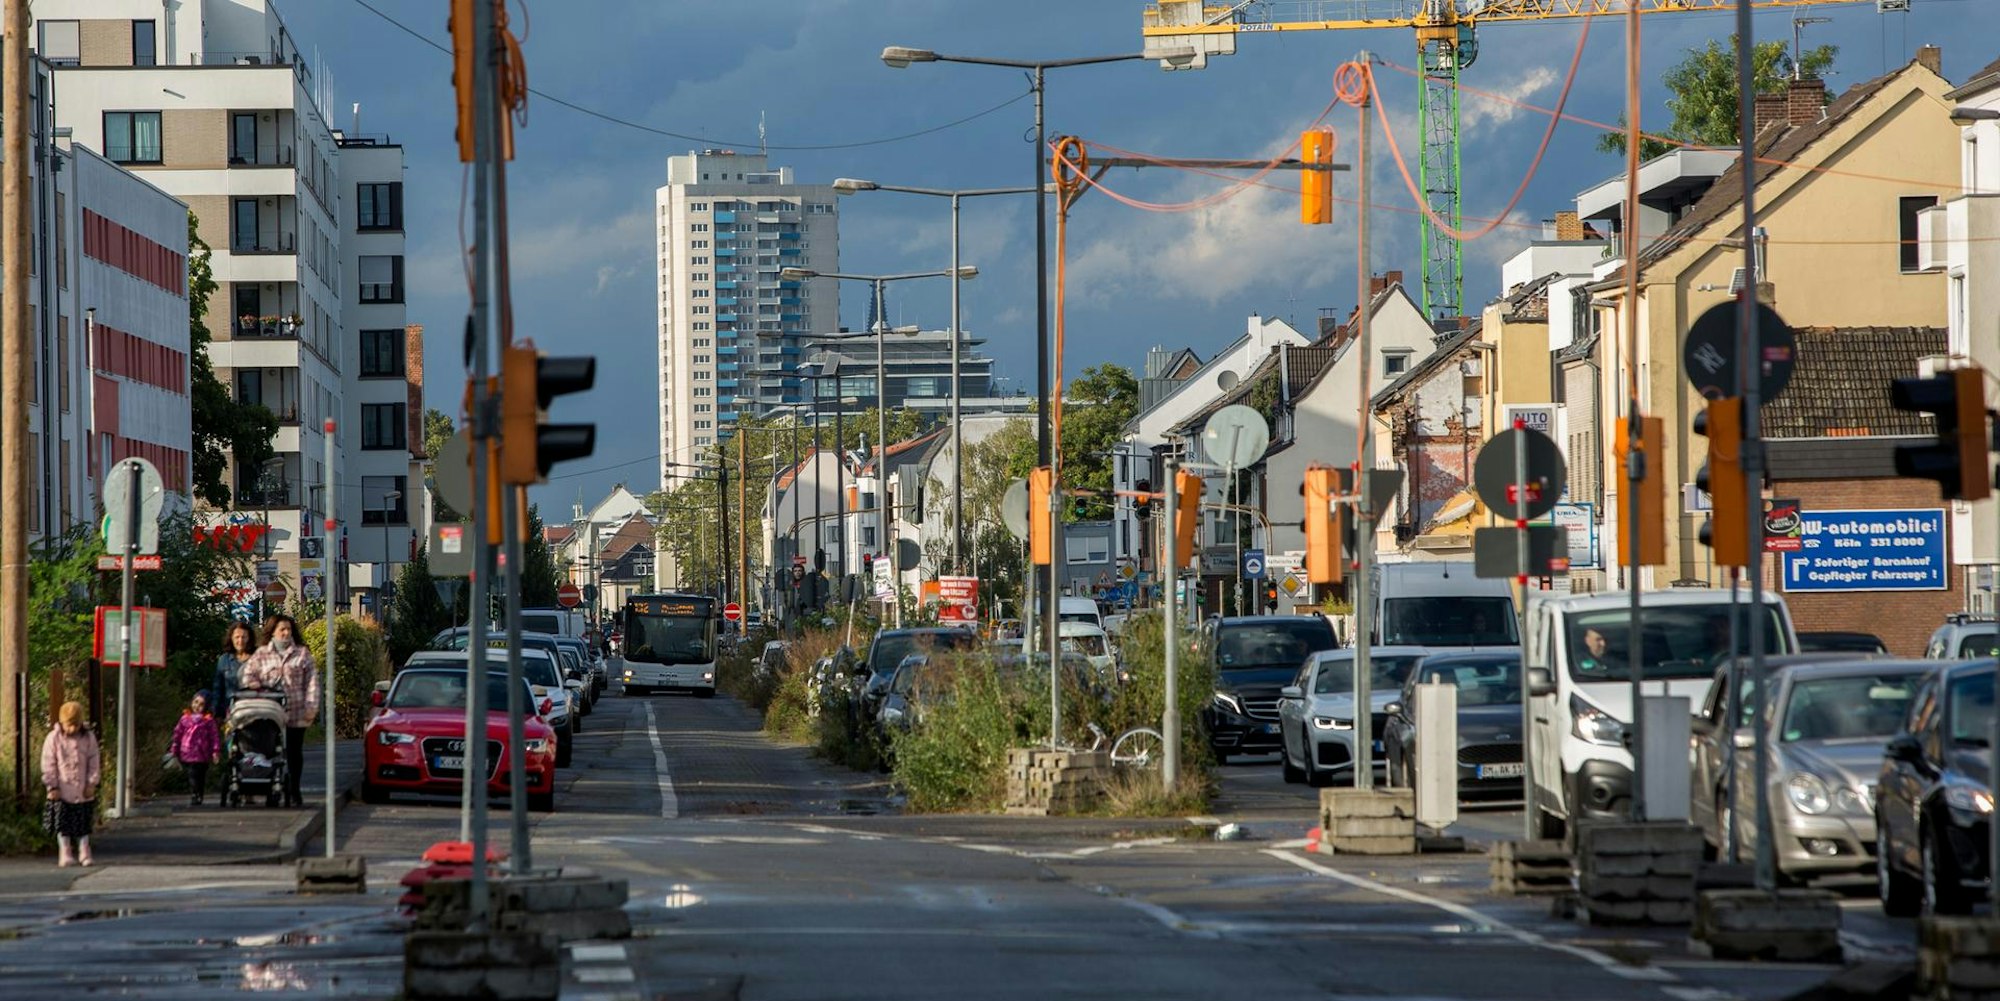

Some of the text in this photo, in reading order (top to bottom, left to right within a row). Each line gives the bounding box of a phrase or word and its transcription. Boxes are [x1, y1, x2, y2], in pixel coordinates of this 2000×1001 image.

[1514, 412, 1548, 423] AUTO
[1834, 537, 1925, 548] Köln 331 8000
[1814, 556, 1931, 568] Sofortiger Barankauf
[1808, 571, 1867, 583] Gepflegter
[1871, 569, 1927, 581] Fahrzeuge
